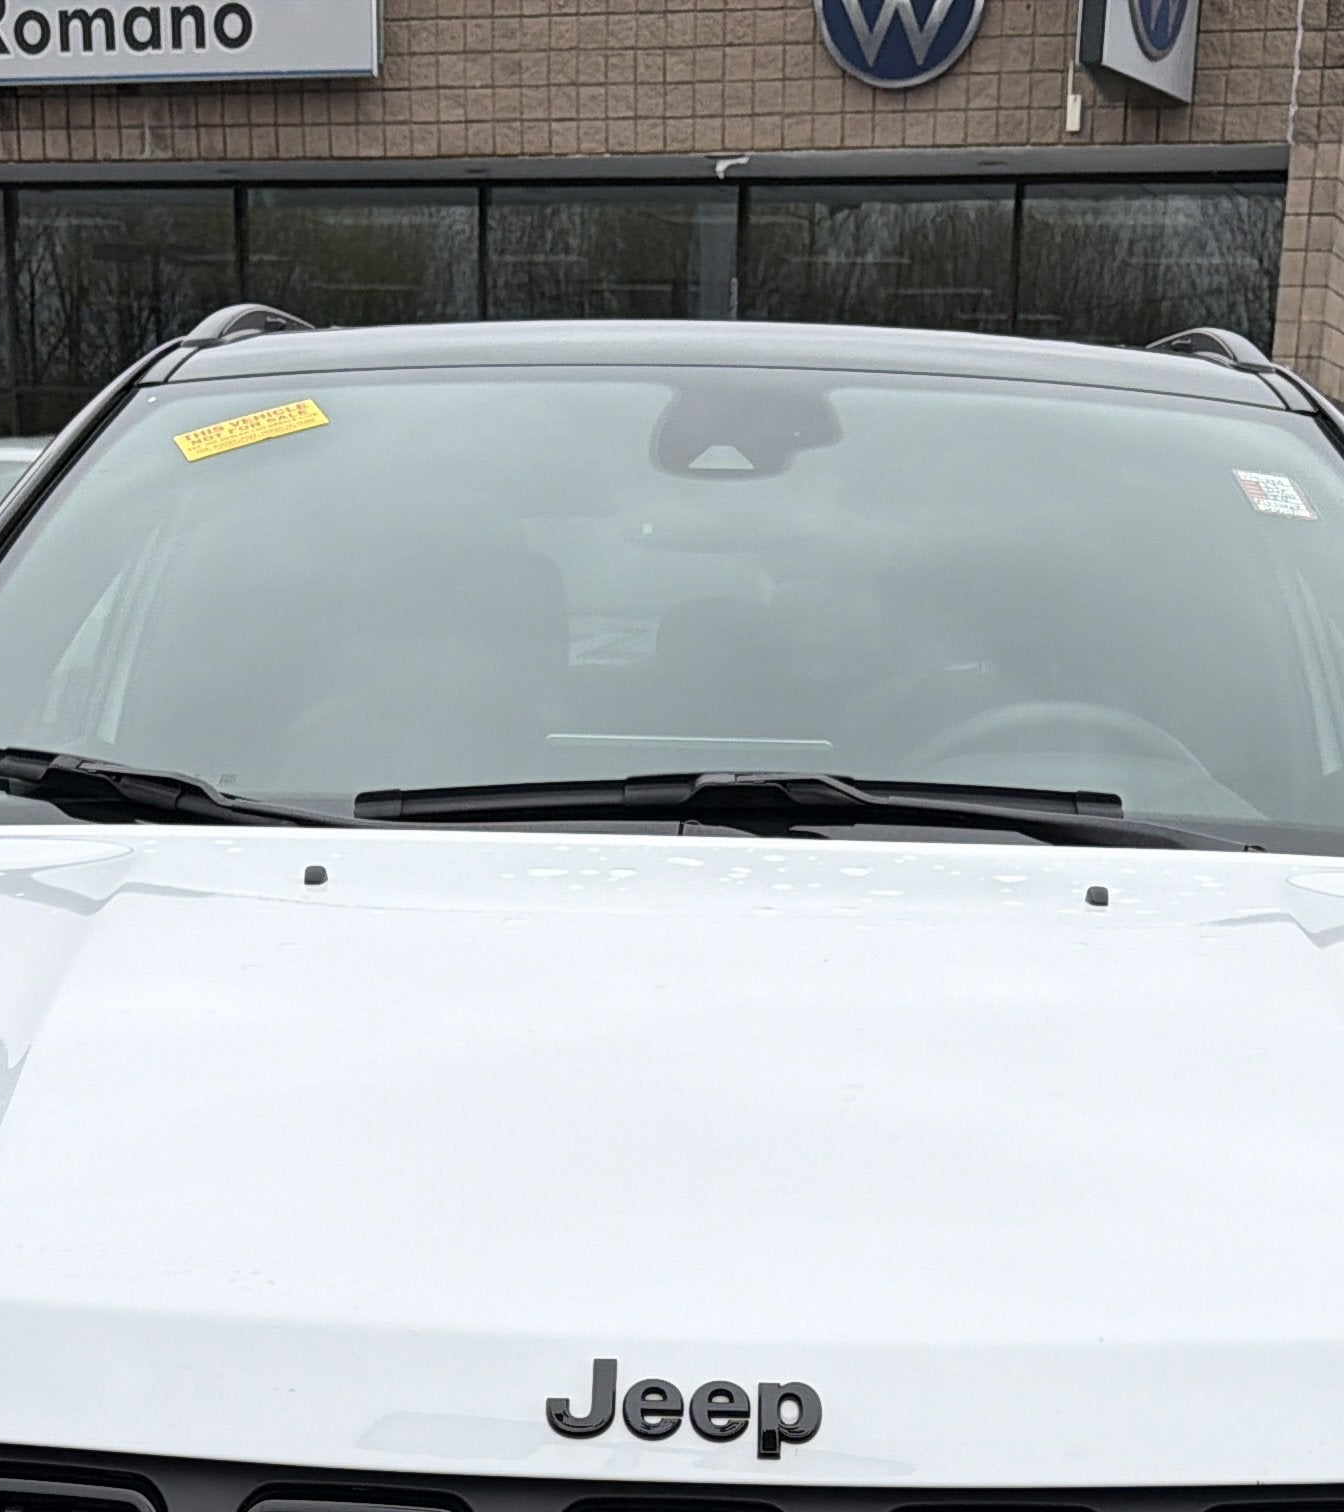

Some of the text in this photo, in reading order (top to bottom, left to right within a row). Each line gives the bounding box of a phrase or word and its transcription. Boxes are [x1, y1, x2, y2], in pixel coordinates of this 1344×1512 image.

[185, 425, 224, 441] THIS
[228, 403, 309, 428] VEHICLE
[191, 409, 308, 446] NOT FOR SALE
[546, 1358, 822, 1460] Jeep
